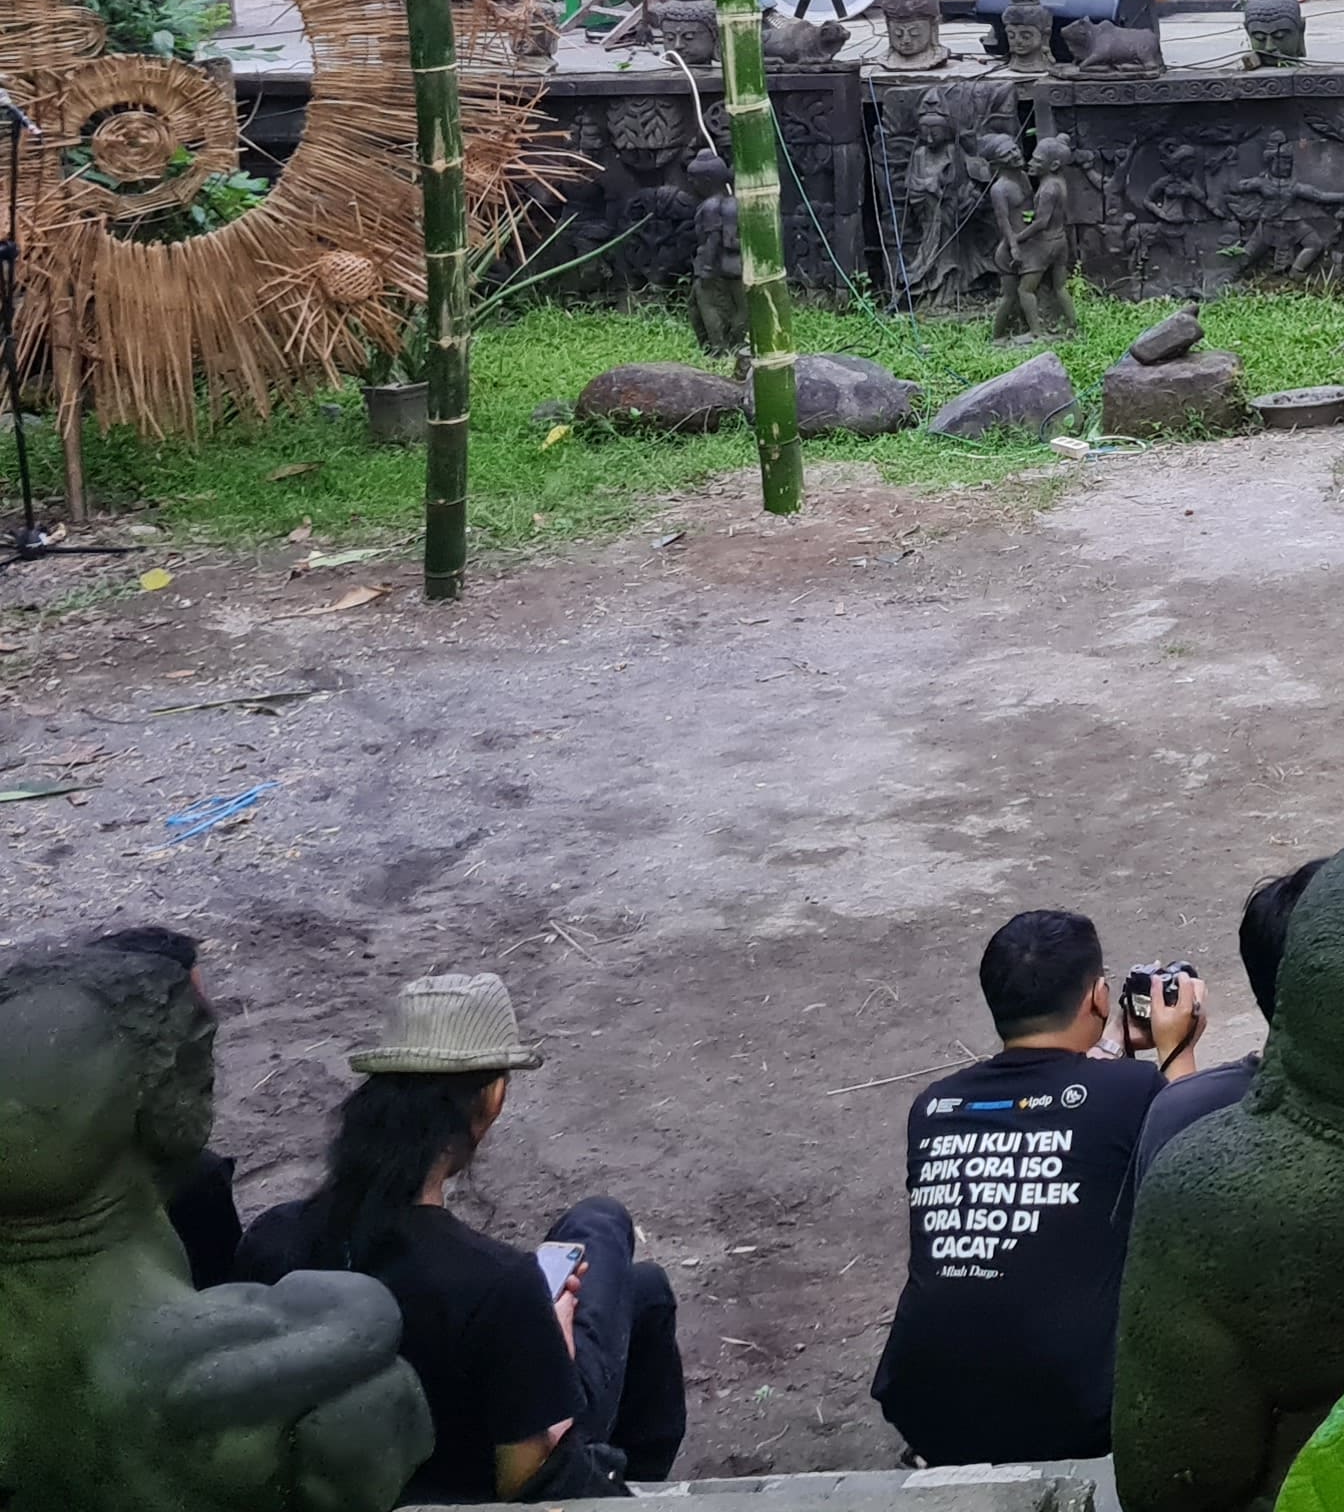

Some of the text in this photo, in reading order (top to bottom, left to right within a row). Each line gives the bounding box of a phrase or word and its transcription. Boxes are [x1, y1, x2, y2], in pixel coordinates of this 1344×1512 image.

[1029, 1094, 1053, 1108] lpdp
[978, 1131, 1022, 1153] KUI
[1027, 1130, 1073, 1153] YEN
[919, 1156, 1063, 1182] APIK ORA ISO
[969, 1183, 1015, 1204] YEN
[1020, 1182, 1081, 1205] ELEK
[924, 1209, 1040, 1232] ORA ISO DI
